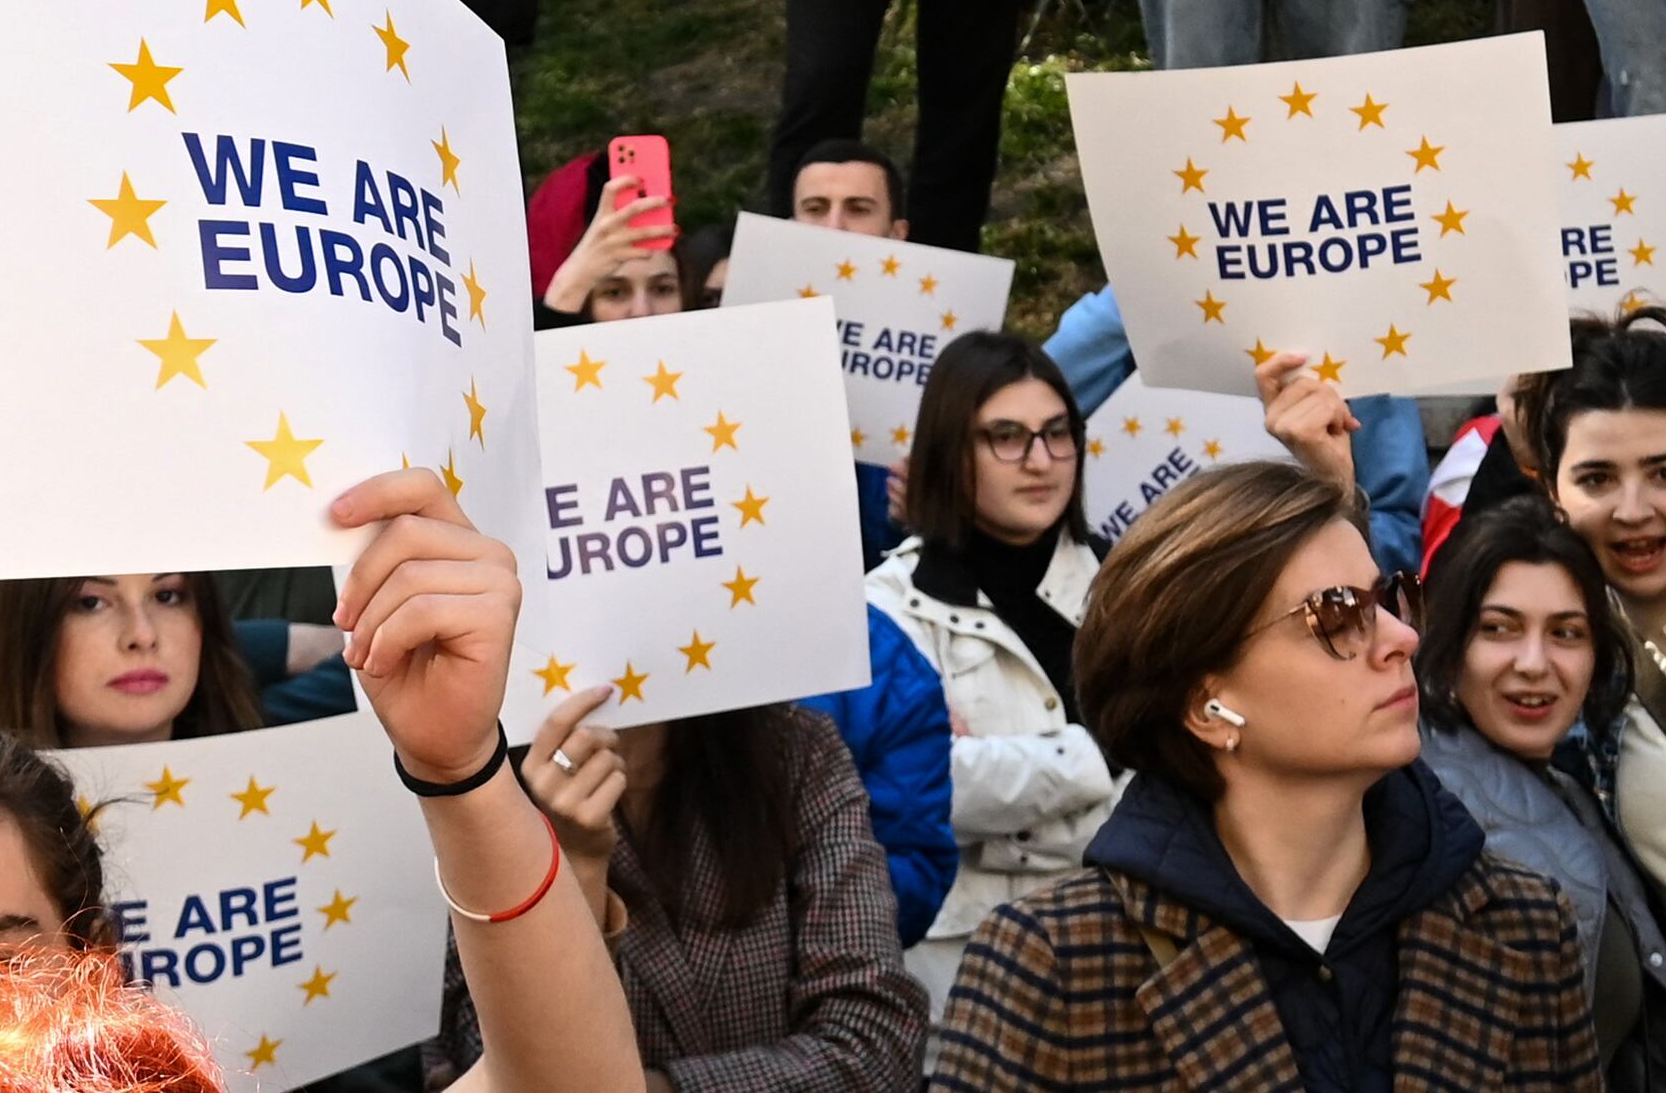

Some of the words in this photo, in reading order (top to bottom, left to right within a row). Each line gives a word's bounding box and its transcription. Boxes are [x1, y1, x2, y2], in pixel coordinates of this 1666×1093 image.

[181, 132, 329, 217] WE
[352, 159, 451, 268] ARE
[1207, 198, 1290, 239] WE
[1308, 184, 1415, 233] ARE
[1215, 227, 1422, 280] EUROPE
[1560, 224, 1615, 257] RE
[197, 219, 462, 348] EUROPE
[836, 319, 864, 347] E
[872, 327, 937, 360] ARE
[544, 483, 584, 530] E
[604, 465, 715, 522] ARE
[1099, 500, 1140, 540] WE
[1139, 446, 1194, 506] ARE
[545, 515, 724, 581] UROPE
[113, 900, 151, 944] E
[174, 876, 299, 939] ARE
[122, 923, 304, 988] ROPE
